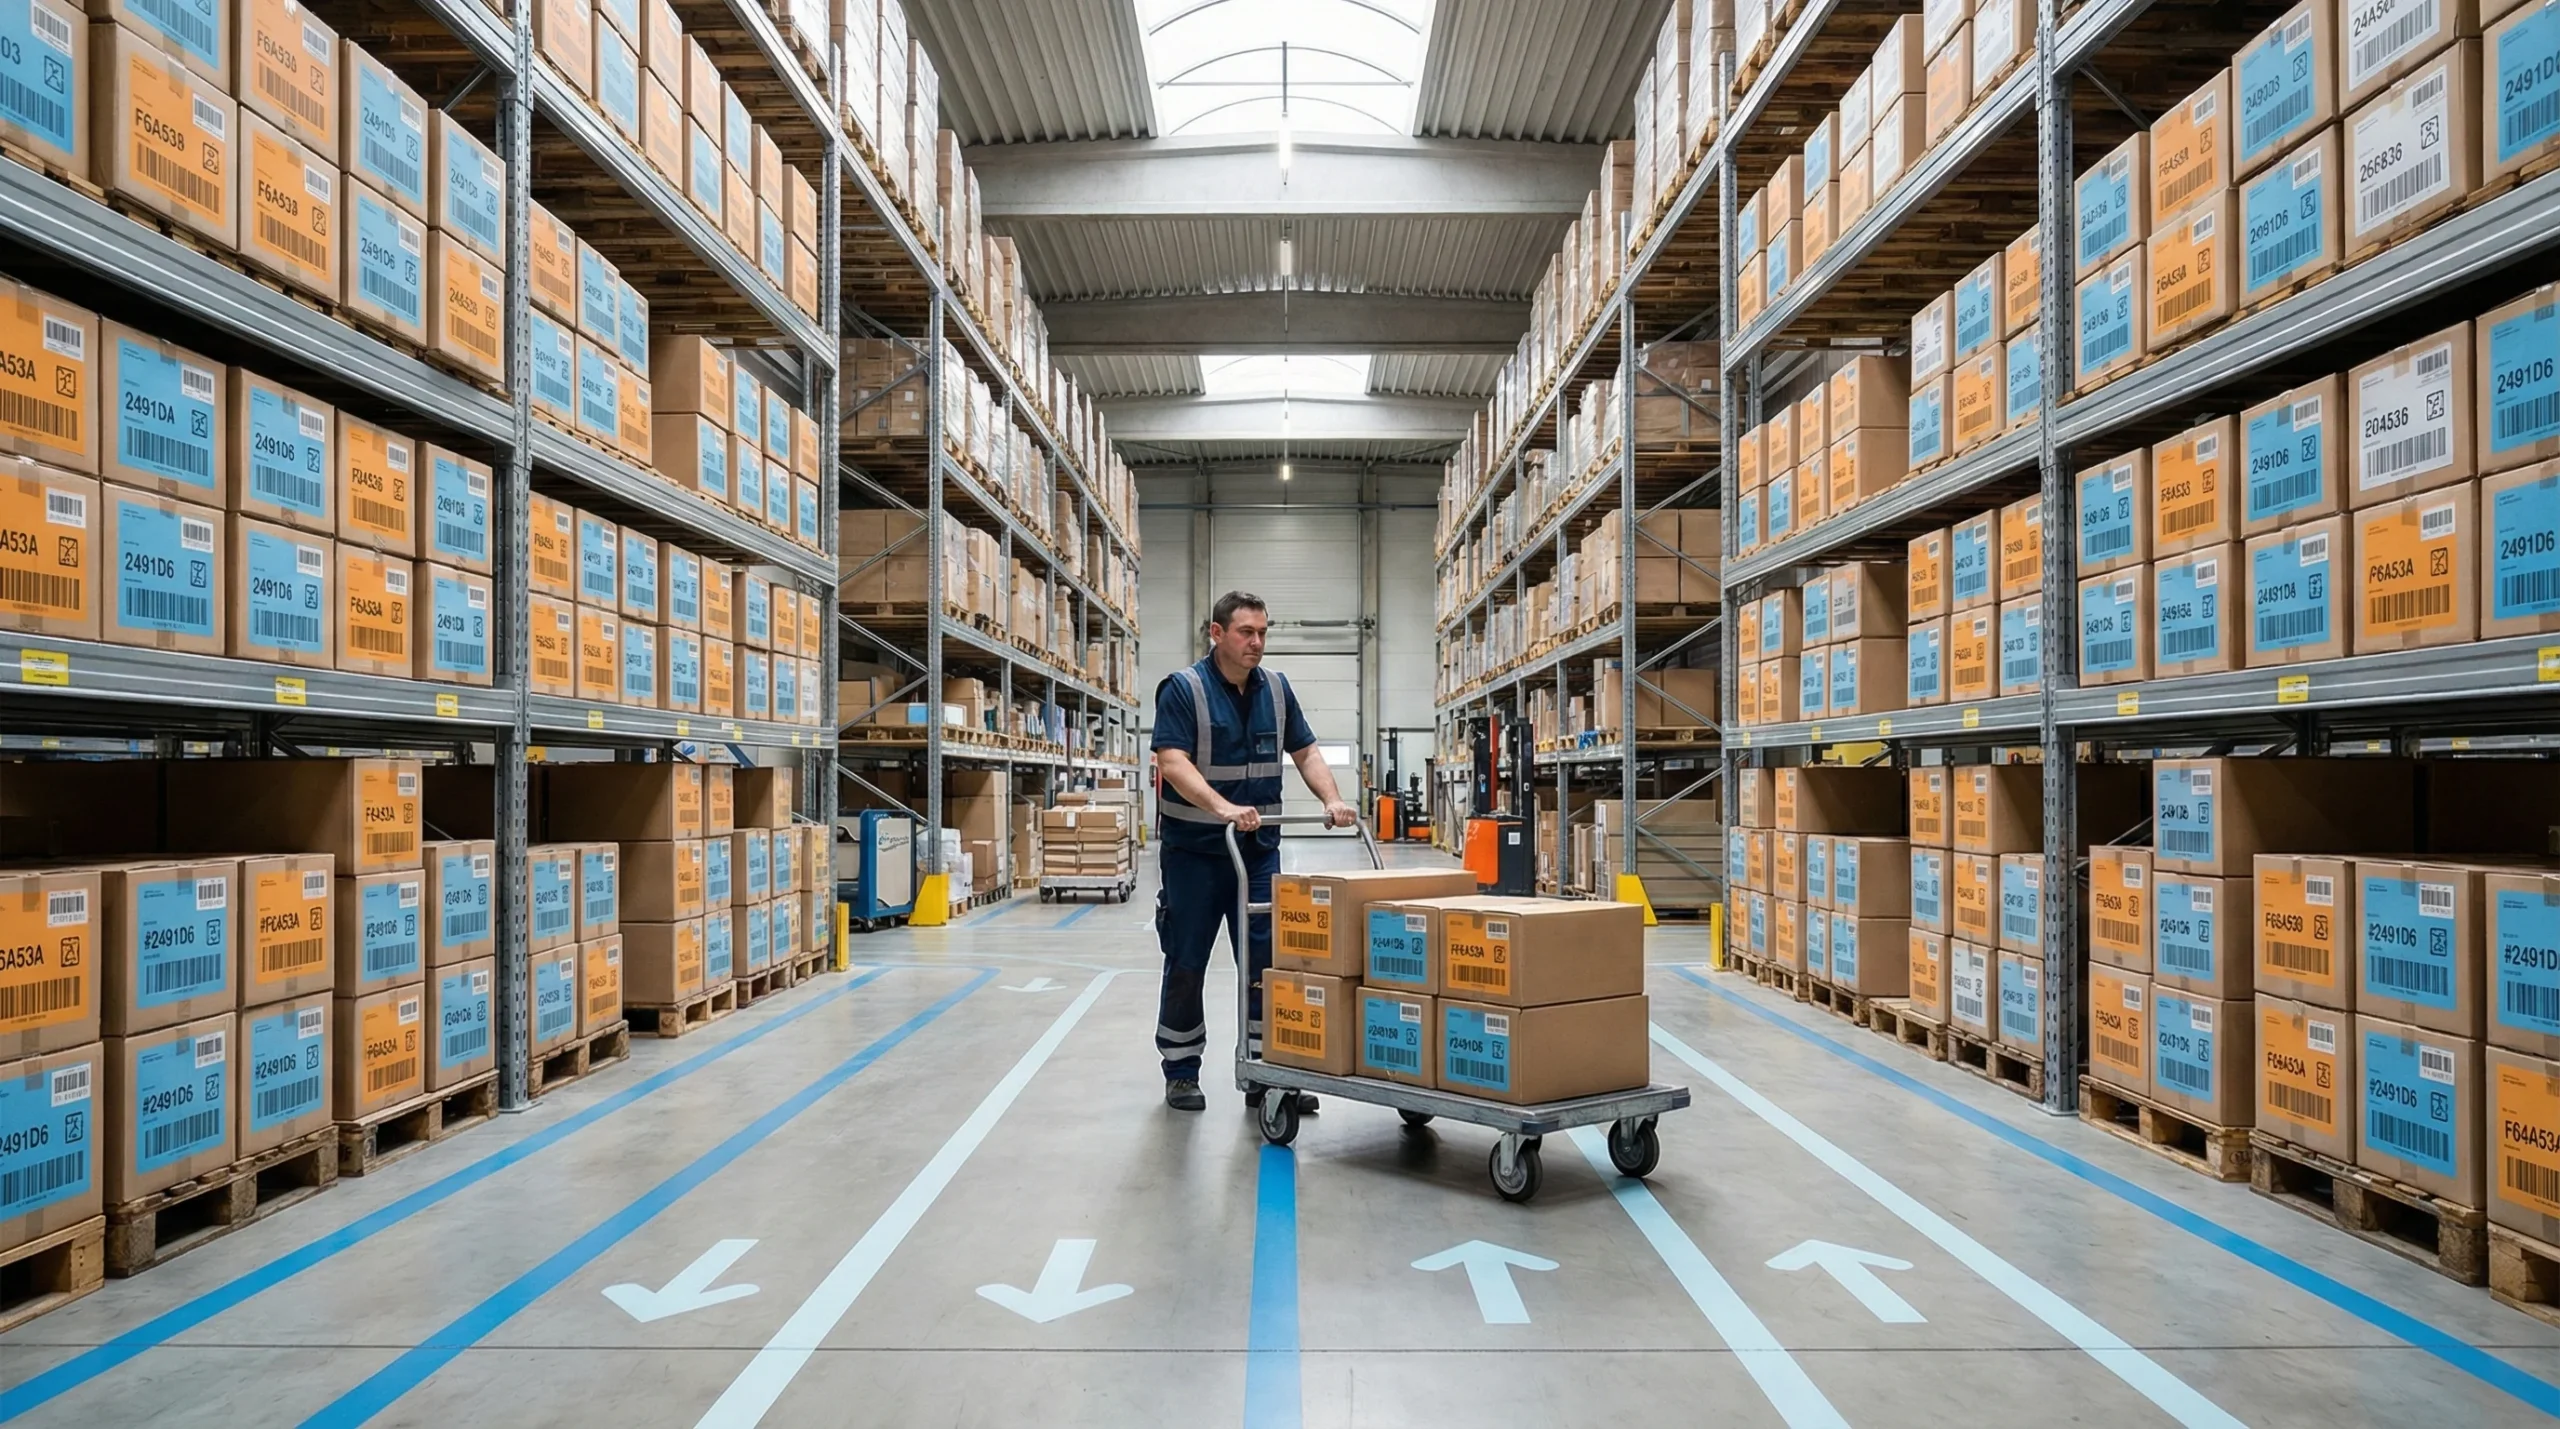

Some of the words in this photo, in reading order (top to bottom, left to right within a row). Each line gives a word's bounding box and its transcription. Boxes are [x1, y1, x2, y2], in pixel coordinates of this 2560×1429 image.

[2497, 357, 2553, 395] 2491D6
[125, 392, 175, 424] 2491DA
[255, 432, 295, 461] 2491D6
[0, 529, 38, 556] A53A
[2501, 529, 2555, 561] 2491D6
[125, 552, 174, 579] 2491D6
[253, 577, 292, 600] 2491D6
[2504, 944, 2560, 971] #2491D
[143, 1084, 193, 1116] #2491D6
[2369, 1078, 2417, 1108] #2491D6
